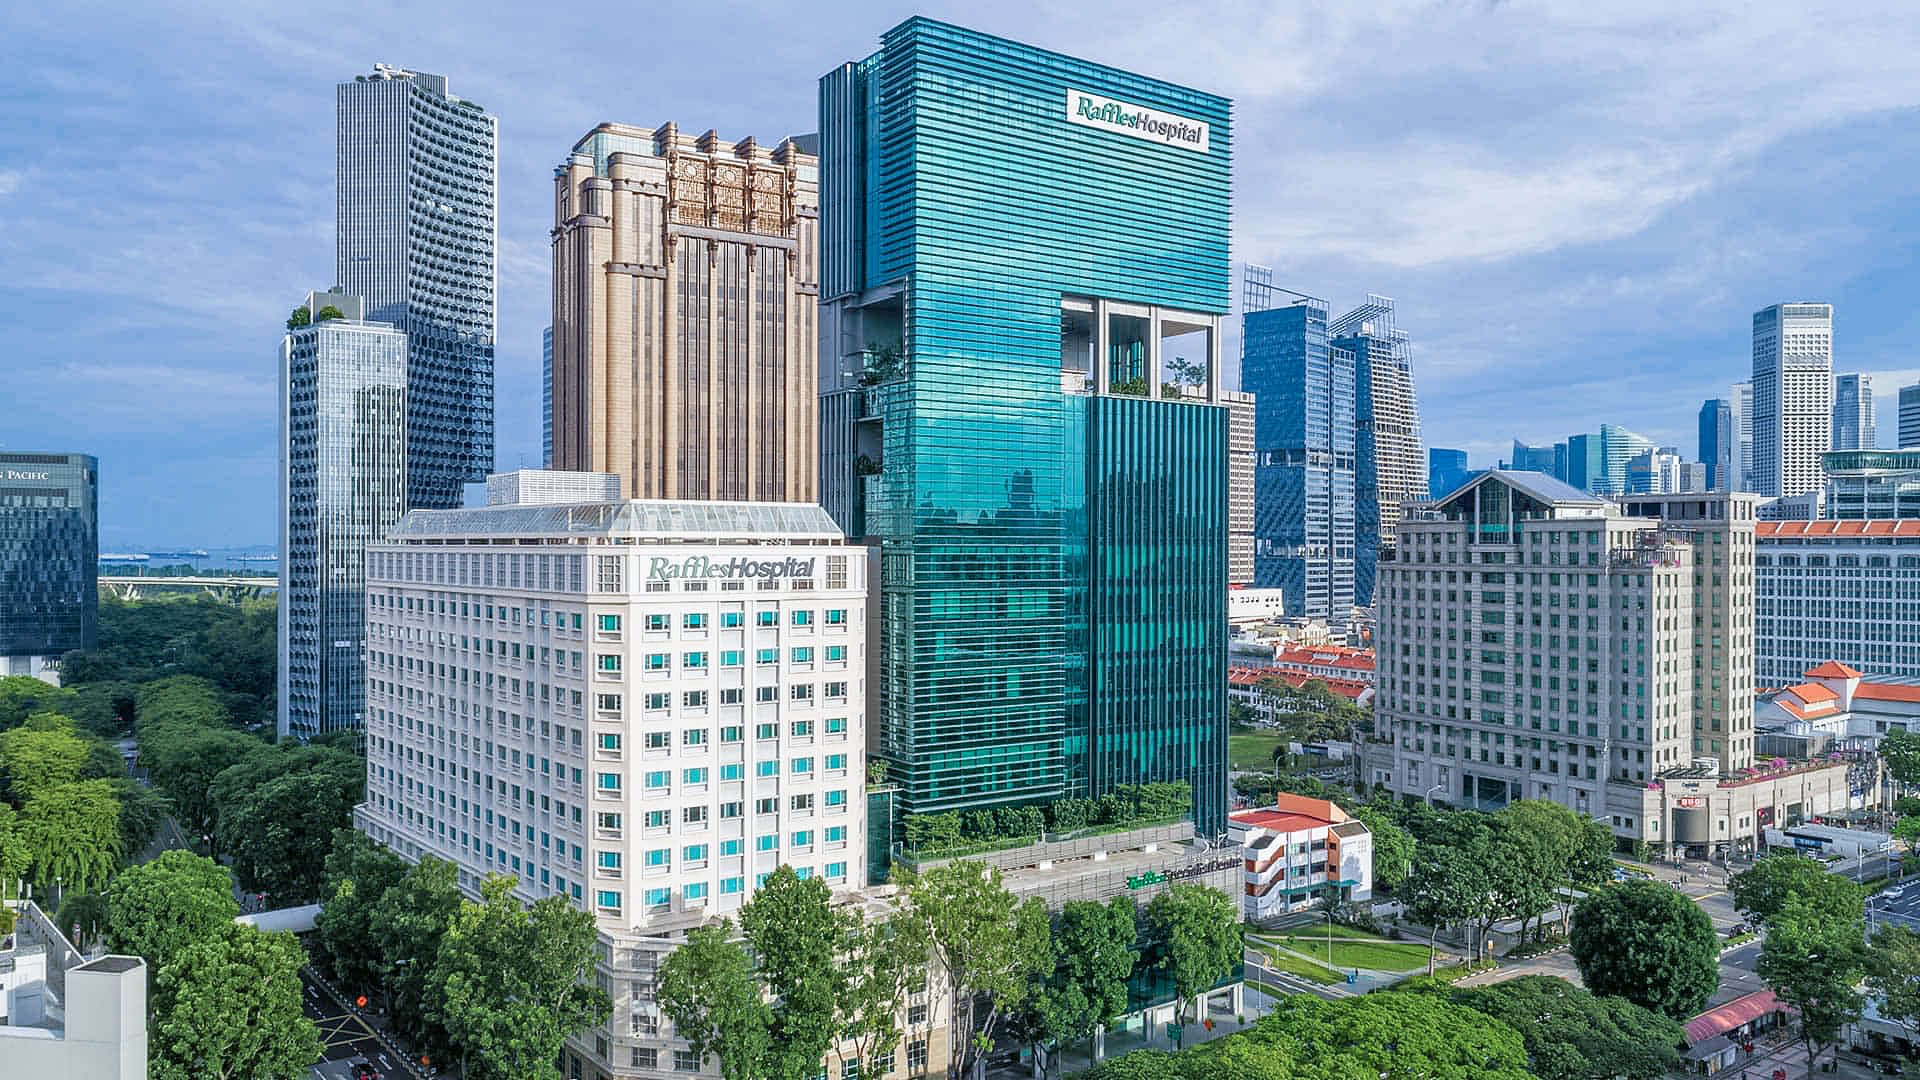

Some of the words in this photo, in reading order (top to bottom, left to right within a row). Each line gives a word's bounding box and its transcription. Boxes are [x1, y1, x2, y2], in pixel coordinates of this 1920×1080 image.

[1076, 96, 1202, 144] RafflesHospital
[8, 470, 48, 480] PACIFIC
[646, 555, 815, 581] RafflesHospital
